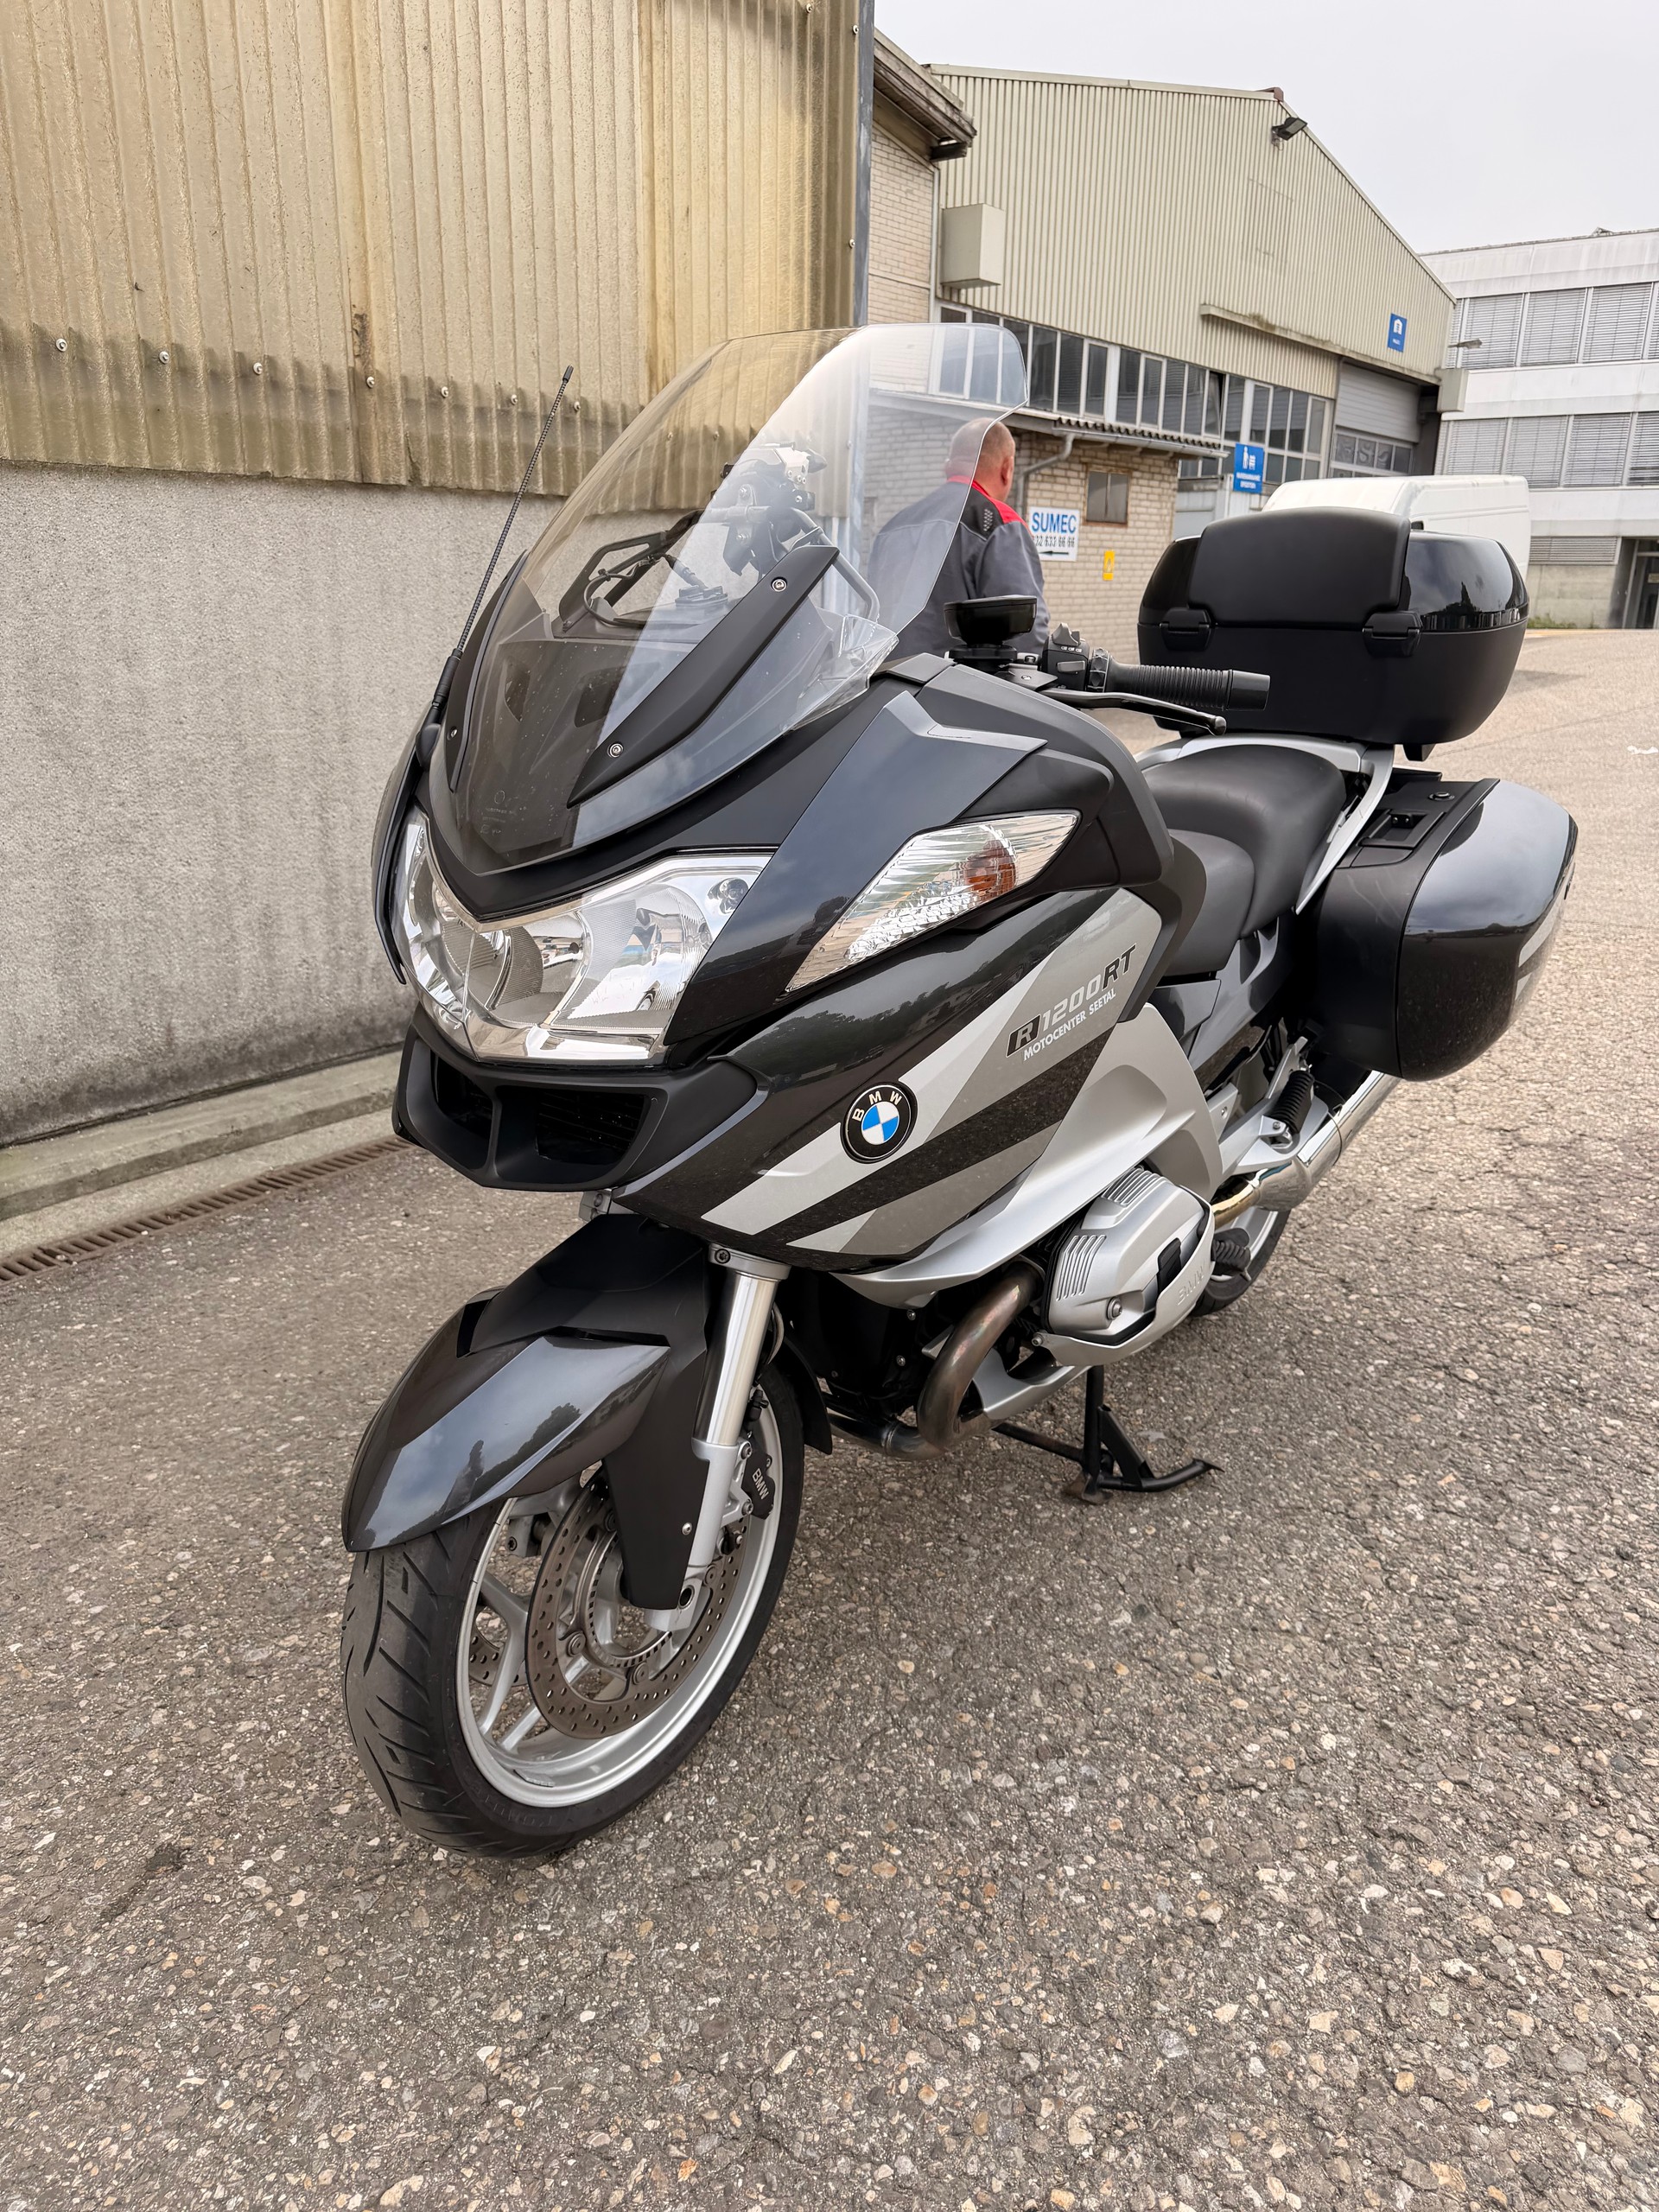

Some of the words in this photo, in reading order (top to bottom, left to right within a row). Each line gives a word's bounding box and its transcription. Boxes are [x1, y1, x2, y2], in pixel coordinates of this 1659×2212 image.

[1032, 512, 1077, 534] SUMEC
[1023, 1010, 1087, 1062] MOTOCENTER
[1089, 988, 1116, 1015] SEETAL
[852, 1090, 903, 1122] BMW
[752, 1468, 769, 1500] BMW
